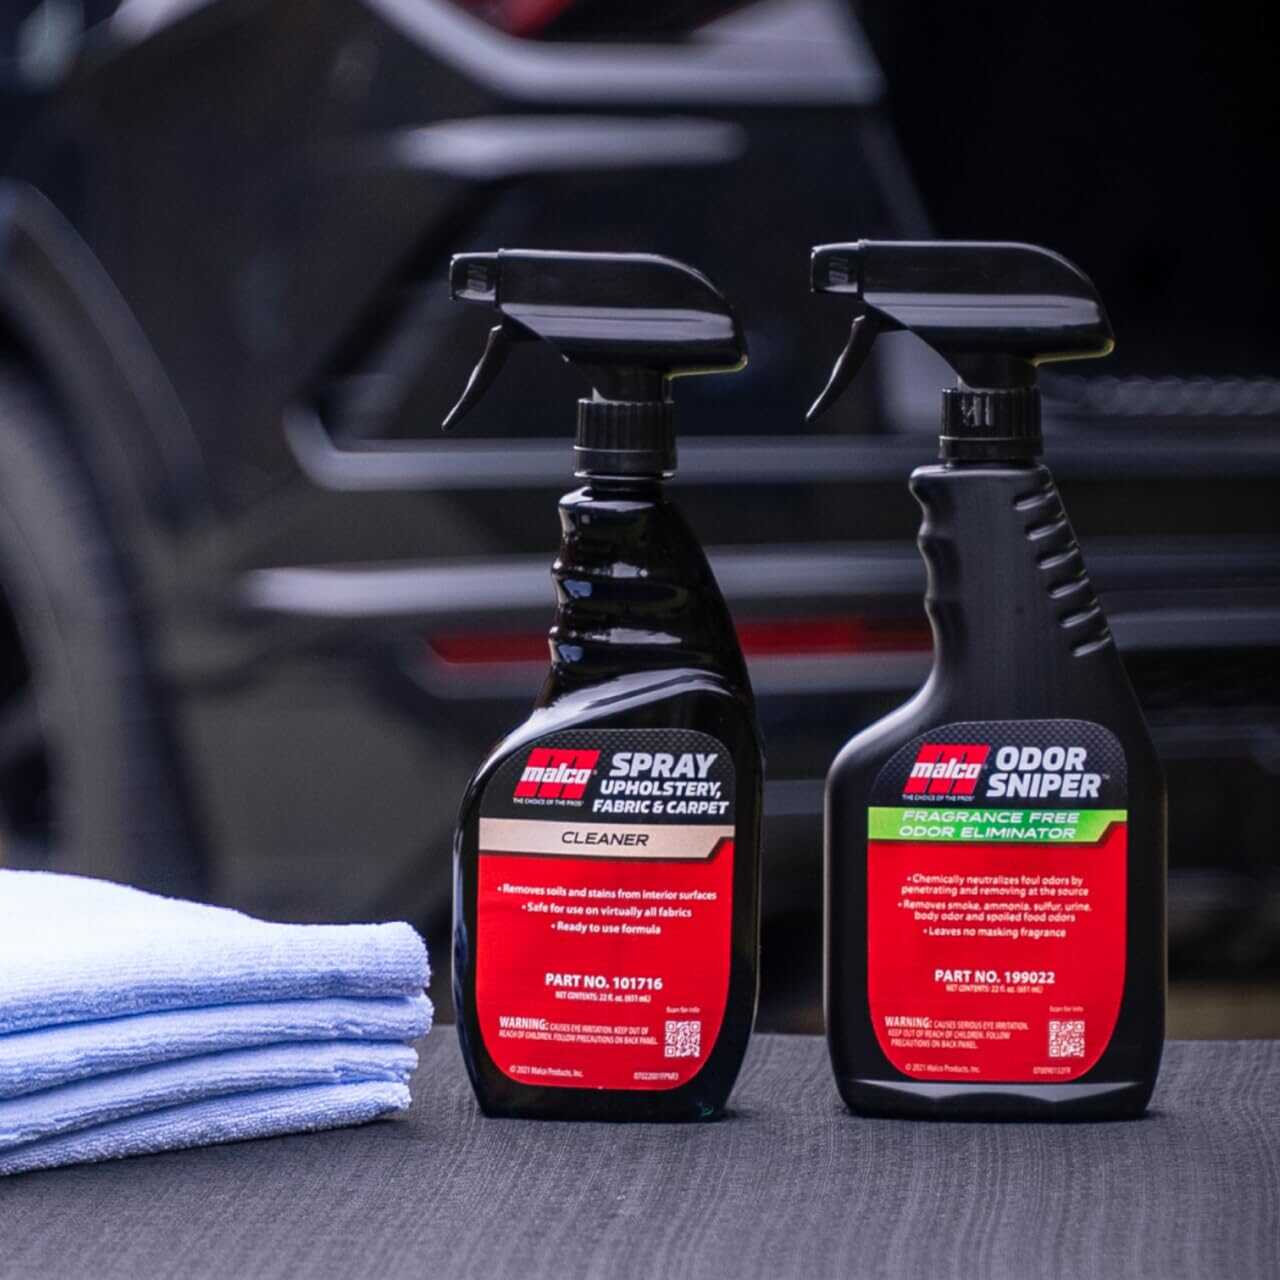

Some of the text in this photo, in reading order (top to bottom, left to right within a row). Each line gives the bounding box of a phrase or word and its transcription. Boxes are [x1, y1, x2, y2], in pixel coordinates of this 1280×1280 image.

[609, 752, 718, 778] SPRAY
[995, 746, 1087, 771] ODOR
[520, 763, 591, 784] malco
[910, 759, 981, 779] malco
[600, 780, 722, 799] UPHOLSTERY,
[986, 773, 1102, 798] SNIPER
[592, 799, 729, 815] FABRIC & CARPET
[902, 810, 1080, 824] FRAGRANCE FREE
[561, 831, 649, 847] CLEANER
[899, 826, 1076, 839] ODOR ELIMINATOR
[913, 873, 1083, 887] Chemically neutralizes foul odors by
[503, 884, 717, 901] Removes soils and stains from interior surfaces
[901, 886, 1089, 898] penetrating and removing at the source
[527, 902, 692, 918] Safe for use on virtually all fabrics
[903, 899, 946, 910] Removes
[914, 911, 1076, 923] body odor and spoiled food odors
[557, 921, 661, 935] Ready to use formula
[929, 926, 1066, 939] Leaves no masking fragrance
[545, 973, 663, 990] PART NO. 101716
[935, 970, 1055, 984] PART NO. 199022
[499, 1016, 550, 1031] WARNING:
[885, 1016, 932, 1029] WARNING:
